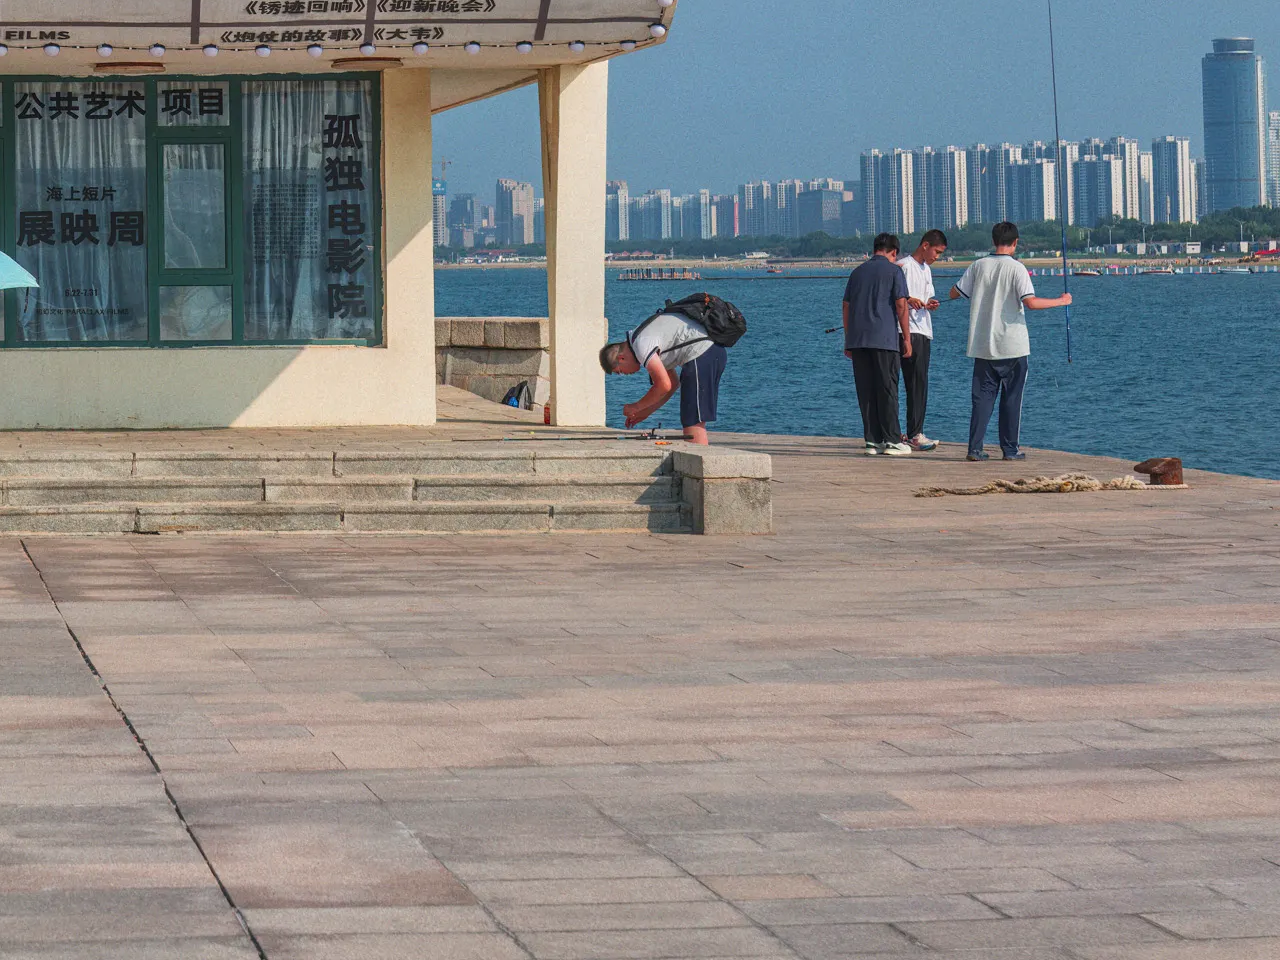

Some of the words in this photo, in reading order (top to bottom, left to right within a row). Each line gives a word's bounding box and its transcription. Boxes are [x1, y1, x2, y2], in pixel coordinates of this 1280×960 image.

[245, 0, 366, 16] 《锈迹回响》
[5, 30, 71, 40] FILMS
[46, 186, 117, 202] 海上短片
[323, 114, 367, 319] 孤独电影院
[16, 209, 144, 247] 展映周
[64, 289, 98, 297] 6.22-7.31
